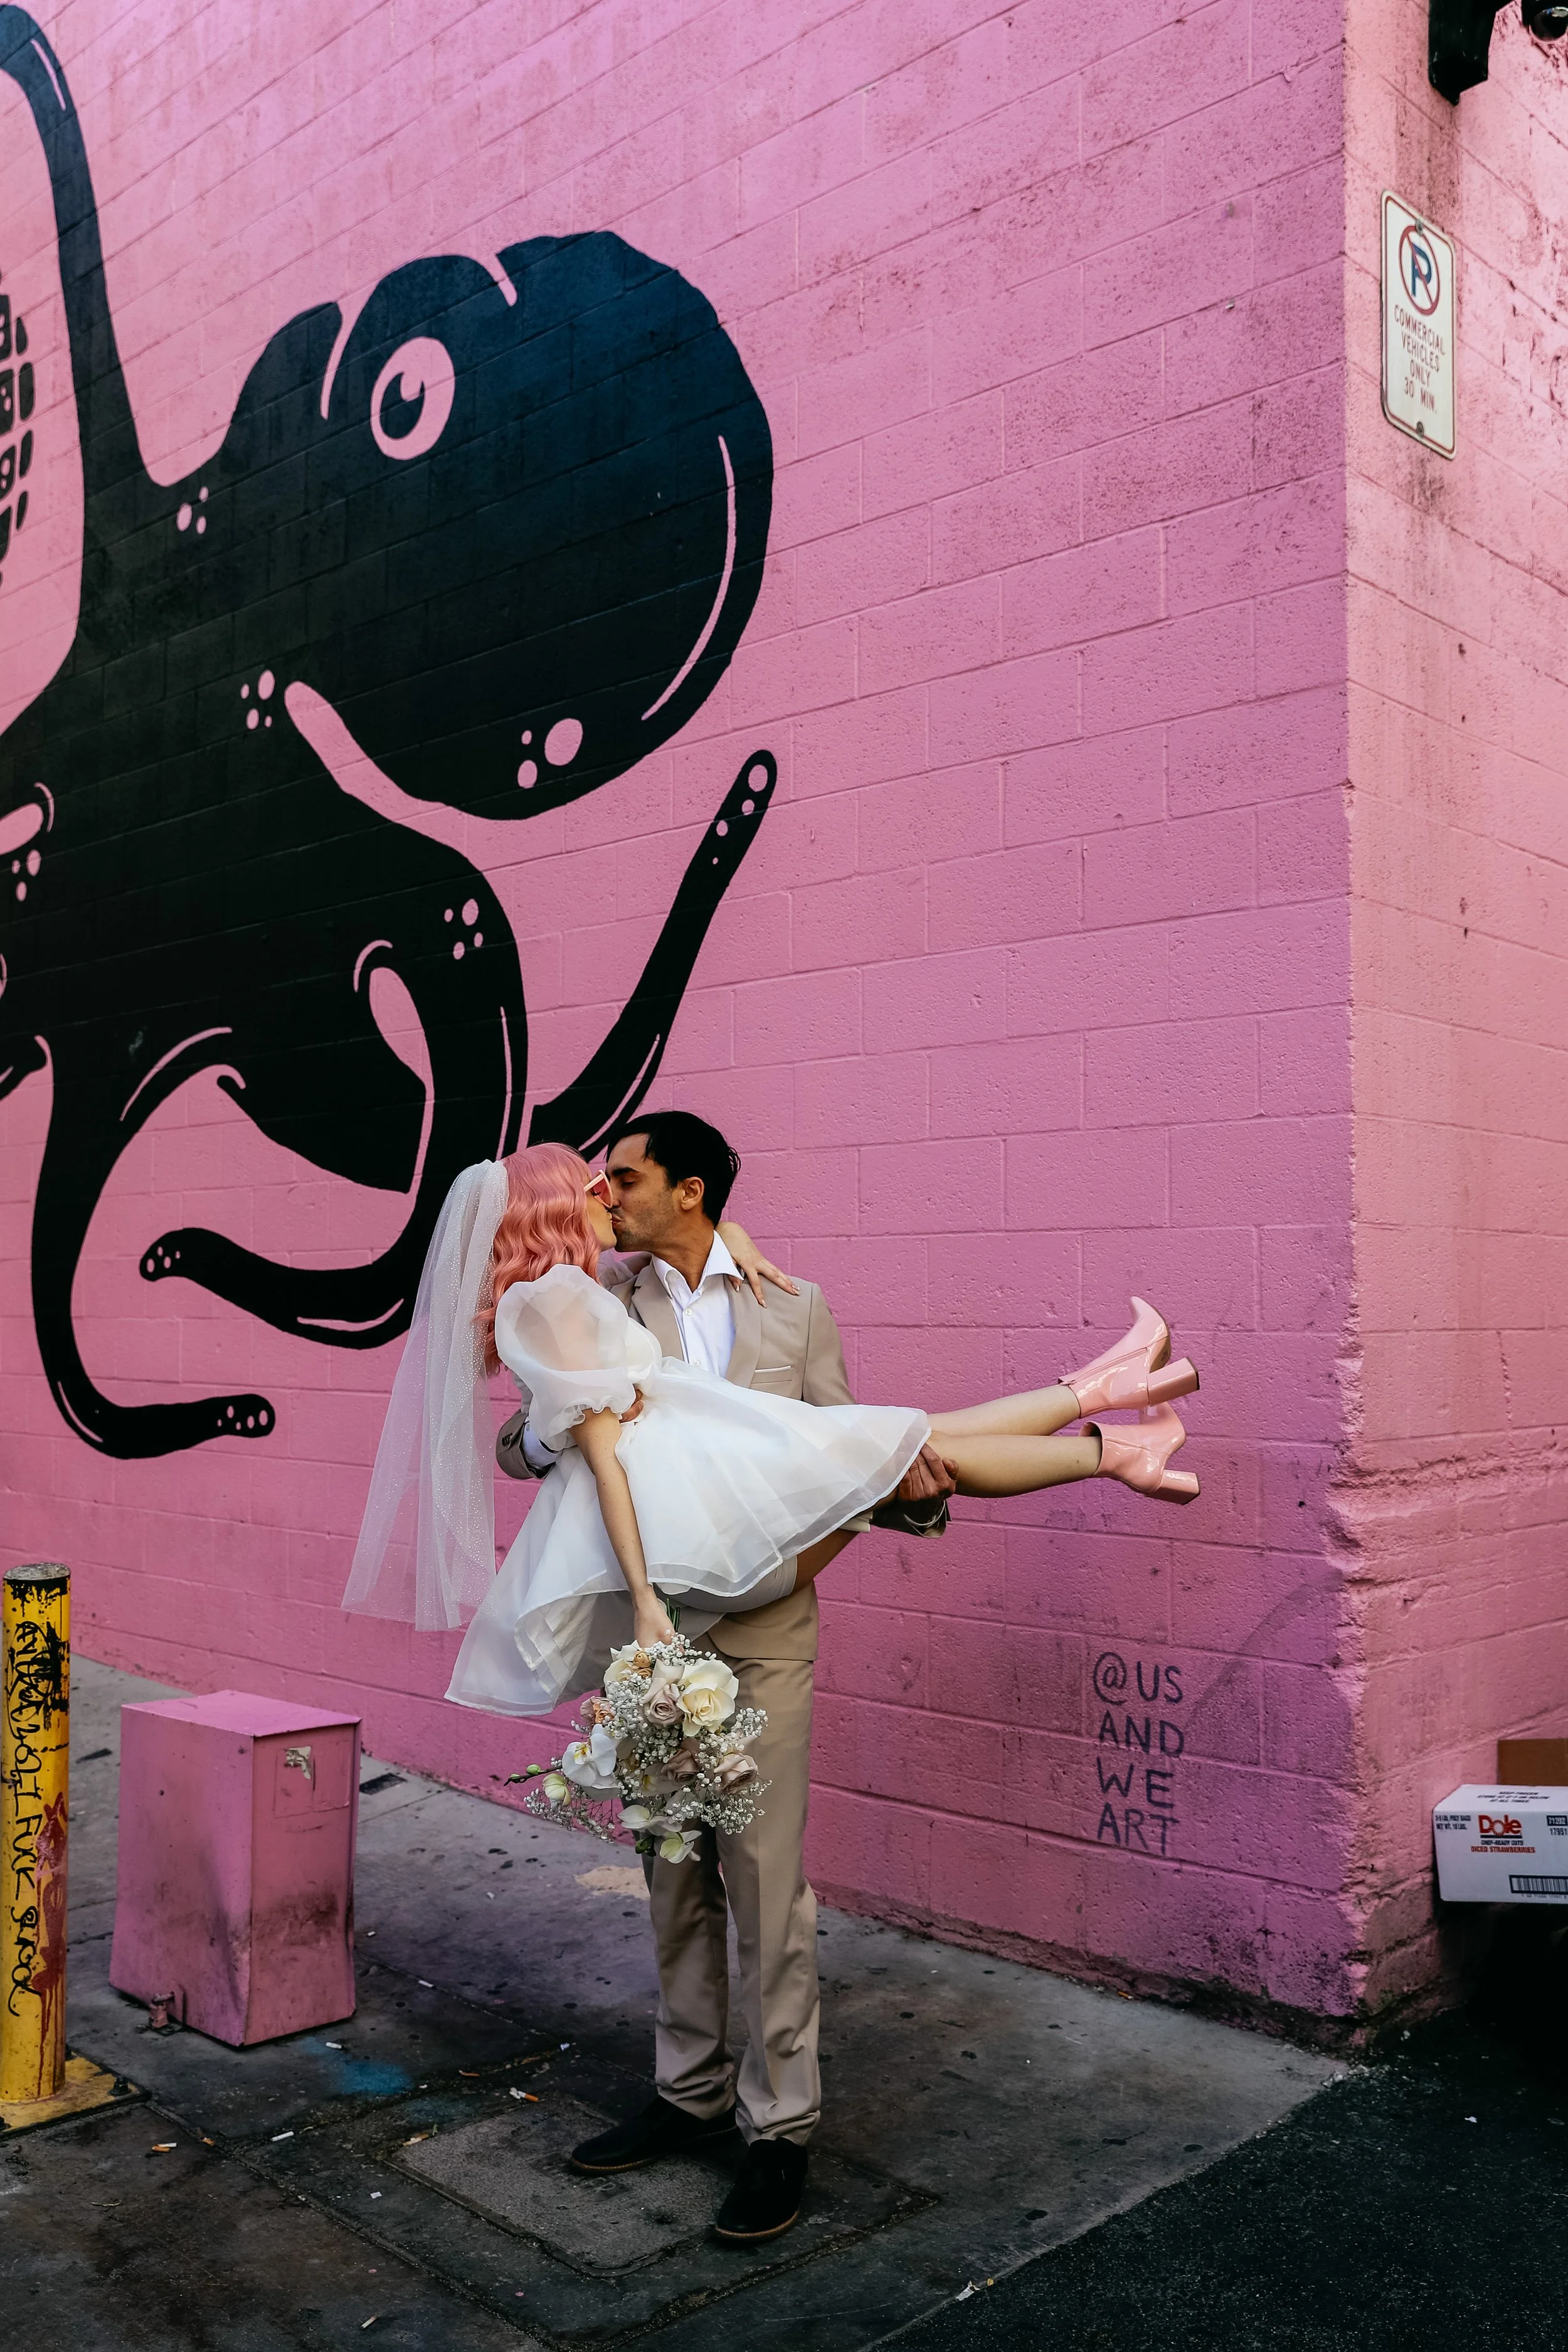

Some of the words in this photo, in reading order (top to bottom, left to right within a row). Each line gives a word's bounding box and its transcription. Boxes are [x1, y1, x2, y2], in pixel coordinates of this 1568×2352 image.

[1394, 305, 1445, 356] COMMERCIAL
[1401, 331, 1439, 372] VEHICLES
[1404, 376, 1414, 398] 30
[1421, 388, 1437, 414] MIN.
[1410, 359, 1431, 387] ONLY
[1093, 1651, 1184, 1706] @US
[1098, 1710, 1184, 1758] AND
[1098, 1757, 1175, 1809] WE
[1097, 1802, 1180, 1855] ART
[1478, 1814, 1522, 1836] Dole
[12, 1814, 43, 1900] FUCK
